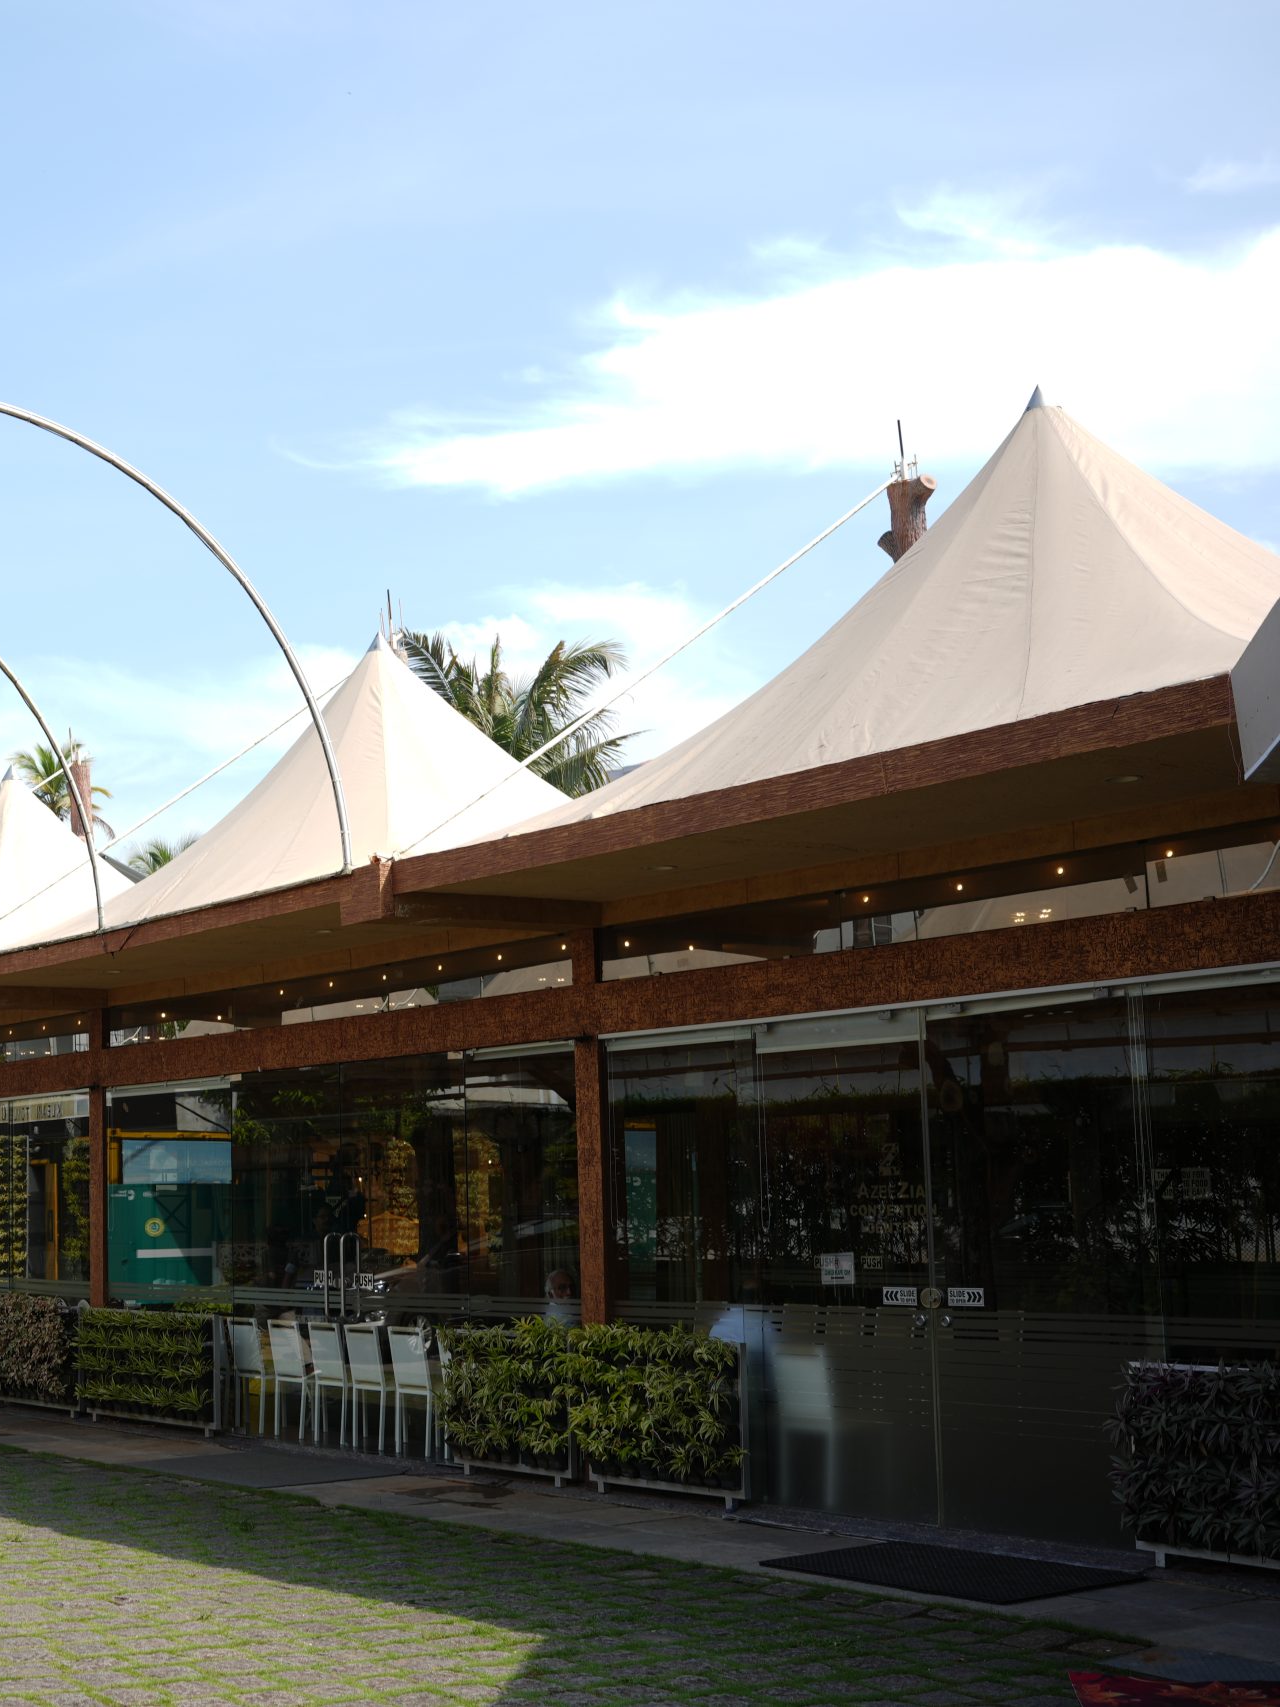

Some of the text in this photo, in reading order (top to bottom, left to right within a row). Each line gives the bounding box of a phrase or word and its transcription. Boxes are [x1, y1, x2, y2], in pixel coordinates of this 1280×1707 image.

[849, 1203, 938, 1218] CONVENTION
[861, 1256, 882, 1268] PUSH
[315, 1272, 332, 1284] PUH
[355, 1275, 372, 1287] PUSH
[899, 1289, 916, 1297] SLIDE
[949, 1290, 966, 1298] SLIDE
